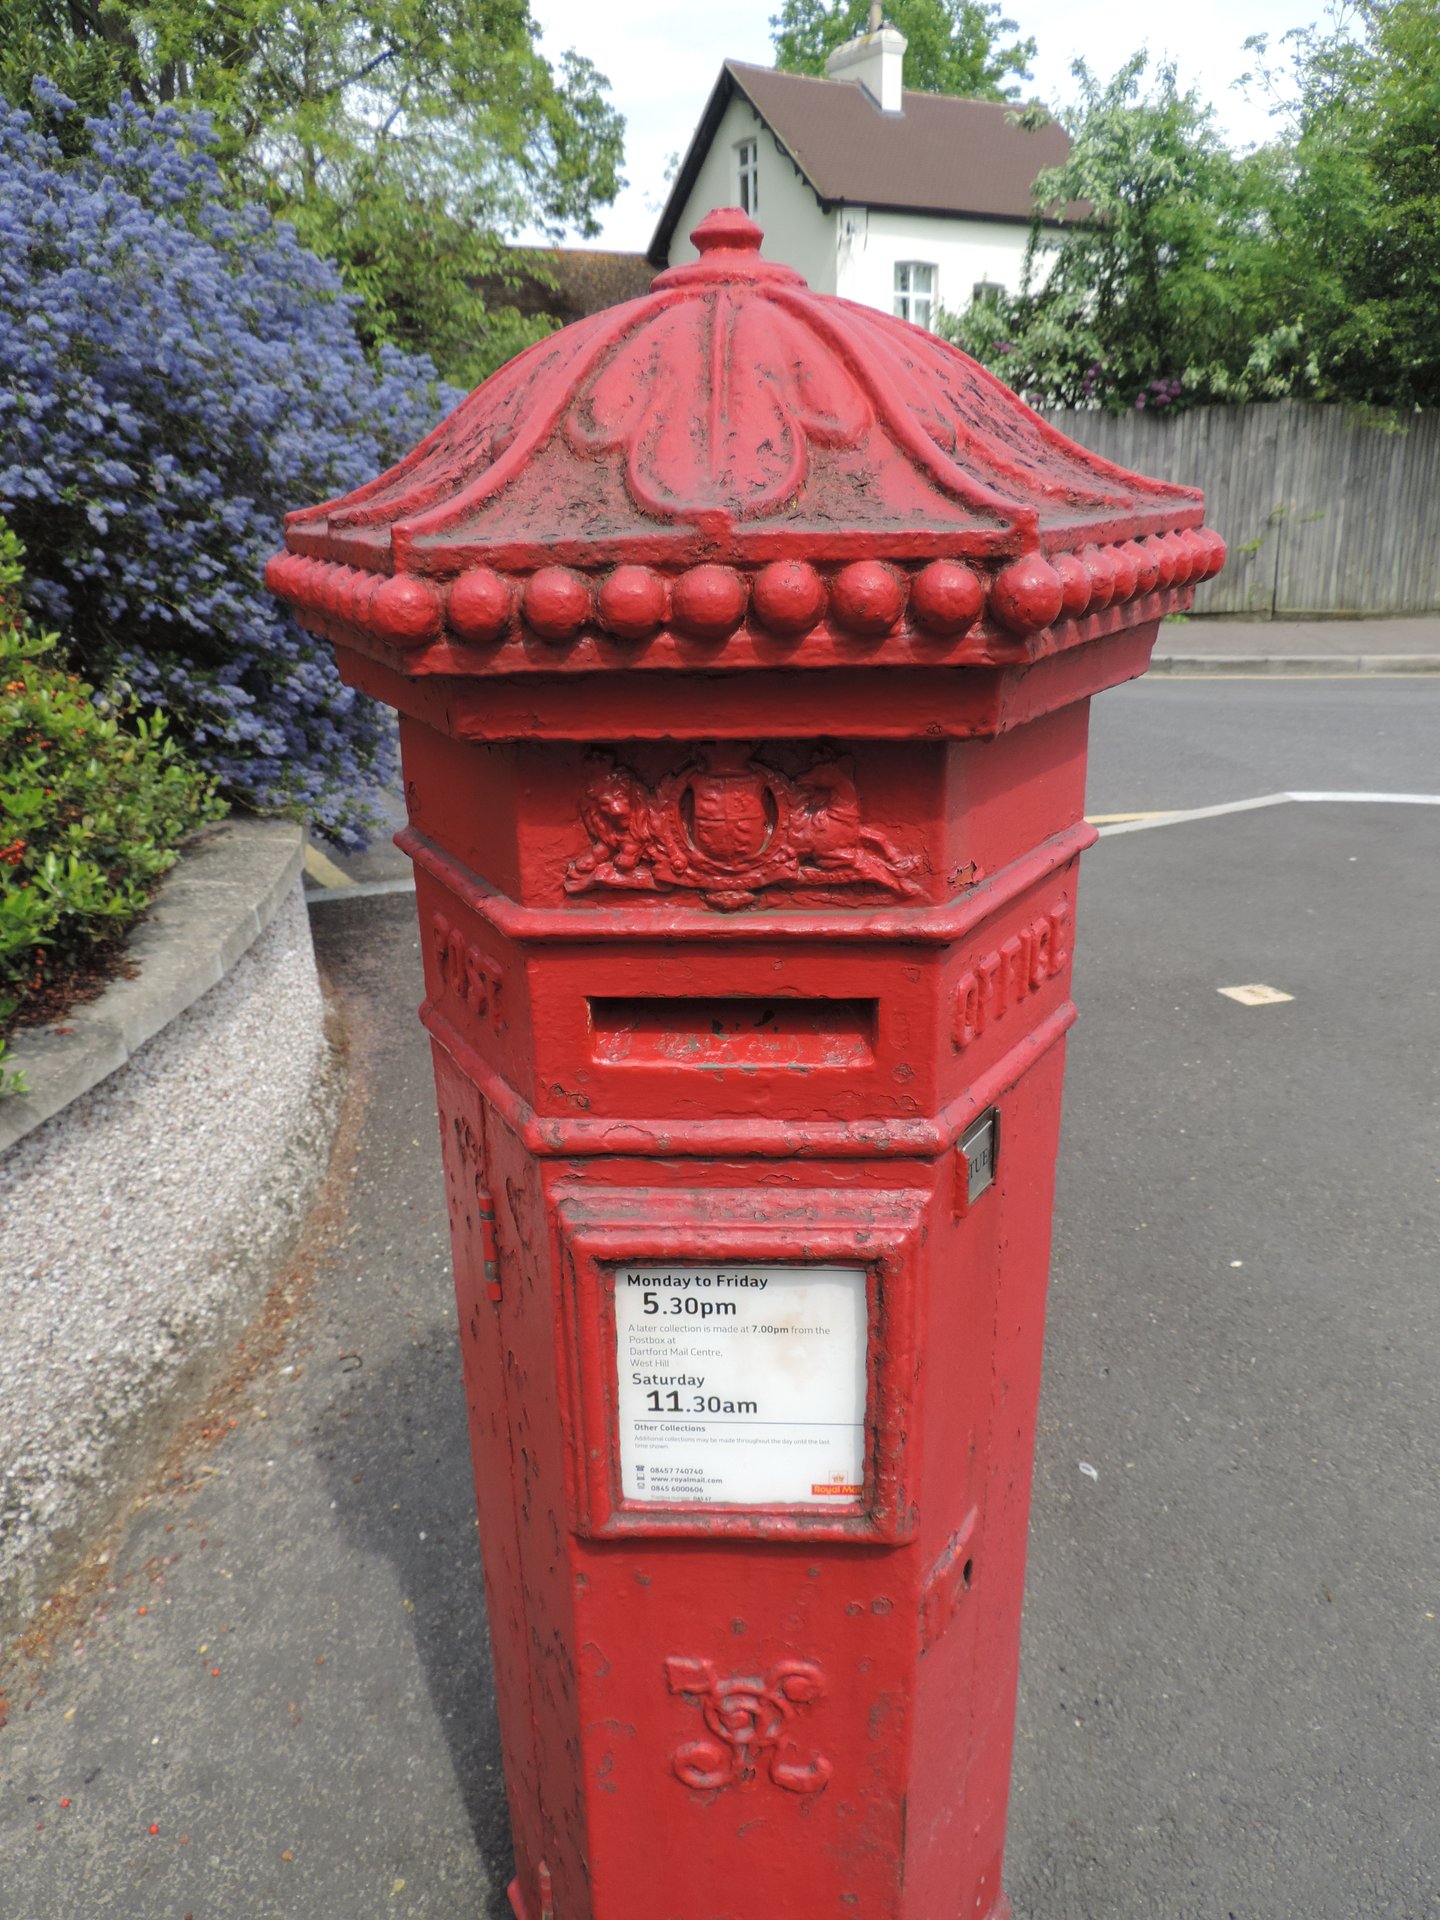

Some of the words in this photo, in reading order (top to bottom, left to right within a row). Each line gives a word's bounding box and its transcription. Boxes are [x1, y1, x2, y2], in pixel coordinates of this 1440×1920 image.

[628, 1275, 690, 1289] Monday
[695, 1276, 711, 1287] to
[717, 1275, 768, 1289] Friday
[643, 1293, 736, 1318] 5.30pm
[704, 1325, 710, 1333] is
[713, 1325, 738, 1333] made
[752, 1325, 789, 1335] 7.00pm
[791, 1326, 813, 1334] from
[630, 1336, 665, 1344] Postbox
[630, 1348, 667, 1356] Dartford
[670, 1348, 688, 1356] Mail
[690, 1348, 723, 1358] Centre,
[631, 1359, 653, 1367] West
[655, 1359, 669, 1367] Hill
[632, 1373, 705, 1388] Saturday
[647, 1391, 757, 1414] 11.30am
[651, 1476, 722, 1484] www.royalmail.com
[672, 1485, 703, 1493] 6000606
[814, 1485, 841, 1495] Royal
